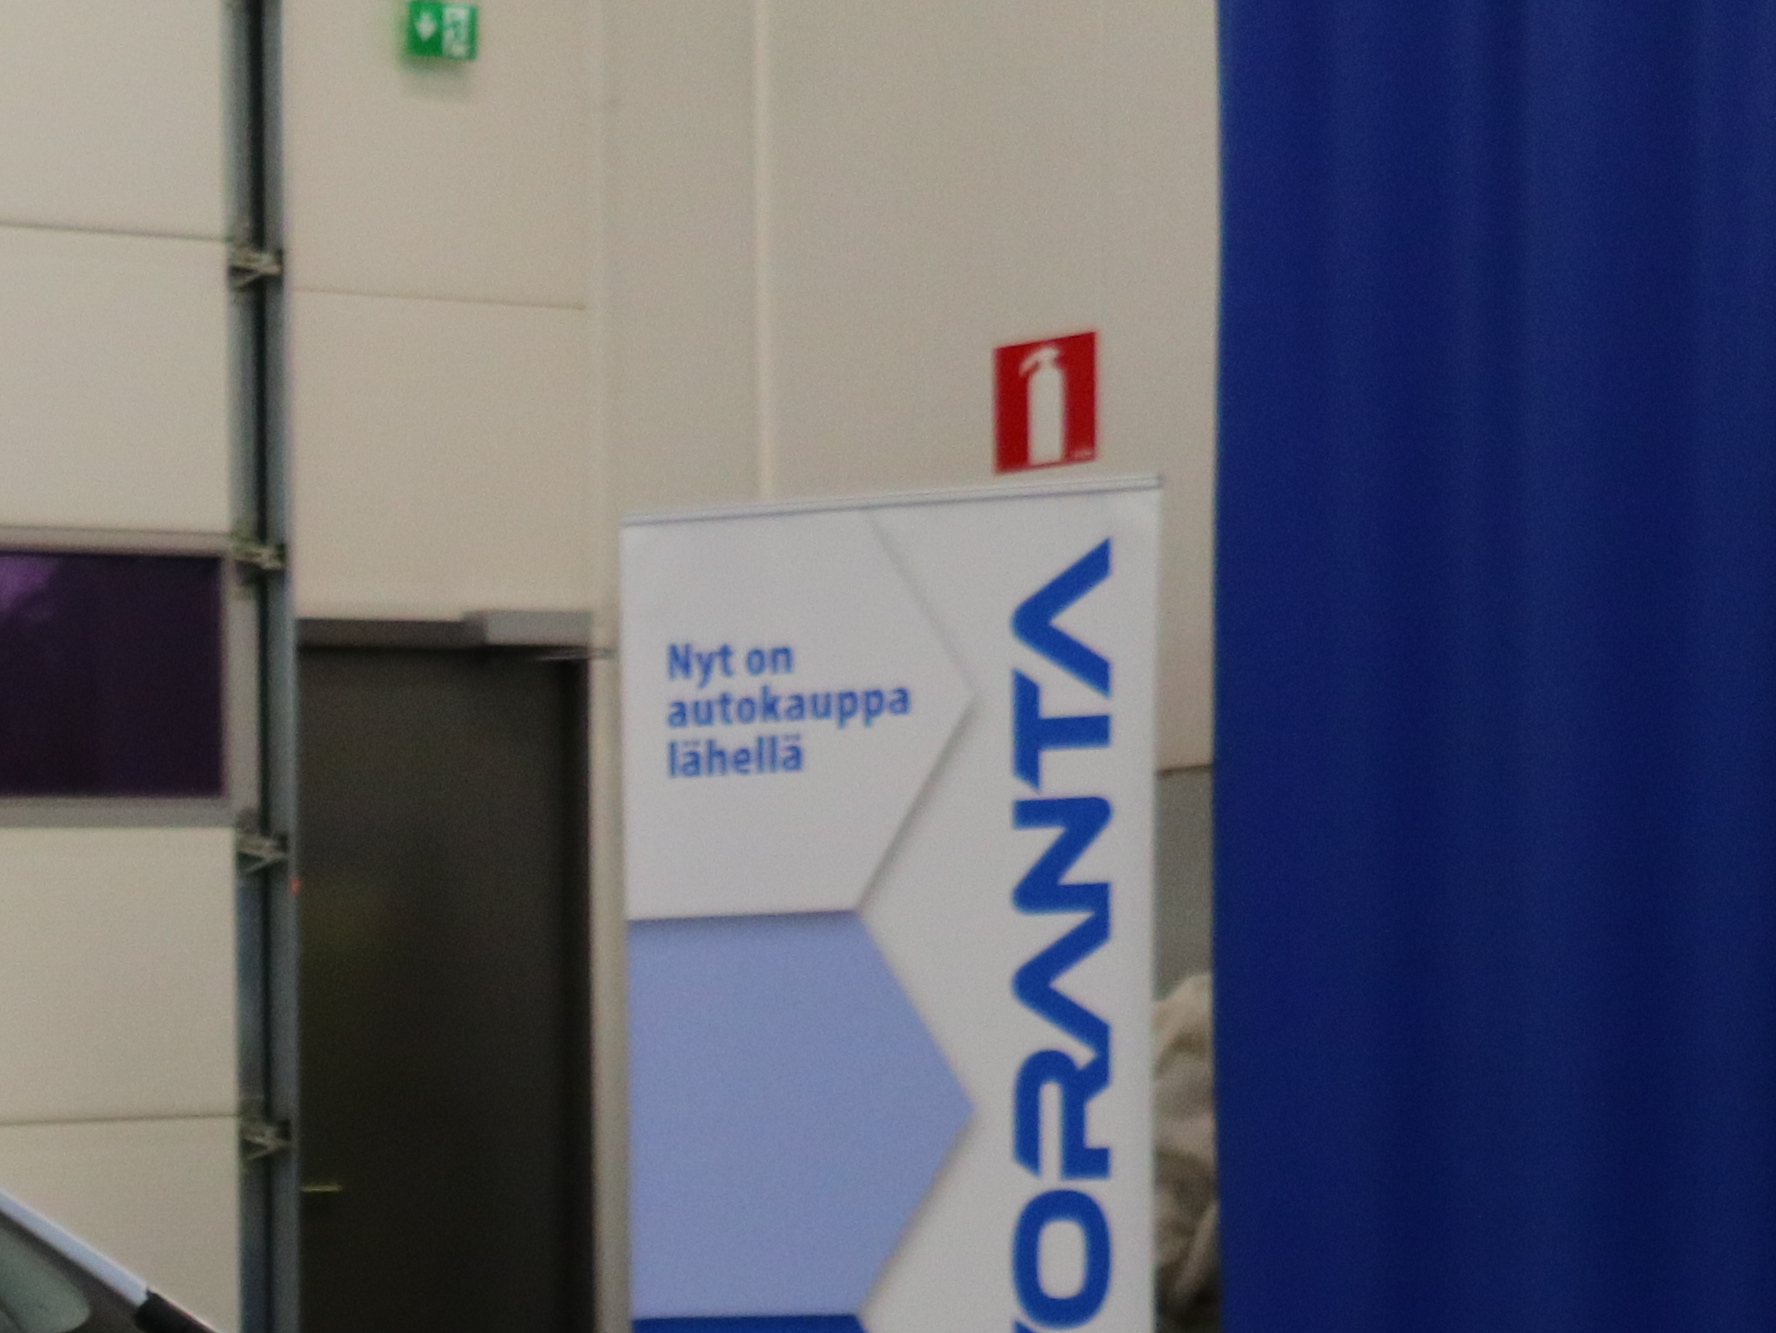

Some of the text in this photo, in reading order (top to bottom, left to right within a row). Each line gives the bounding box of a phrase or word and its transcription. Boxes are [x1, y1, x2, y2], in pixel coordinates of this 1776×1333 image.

[667, 643, 794, 687] Nyt on
[667, 685, 912, 729] autokauppa
[668, 735, 805, 778] lähellä
